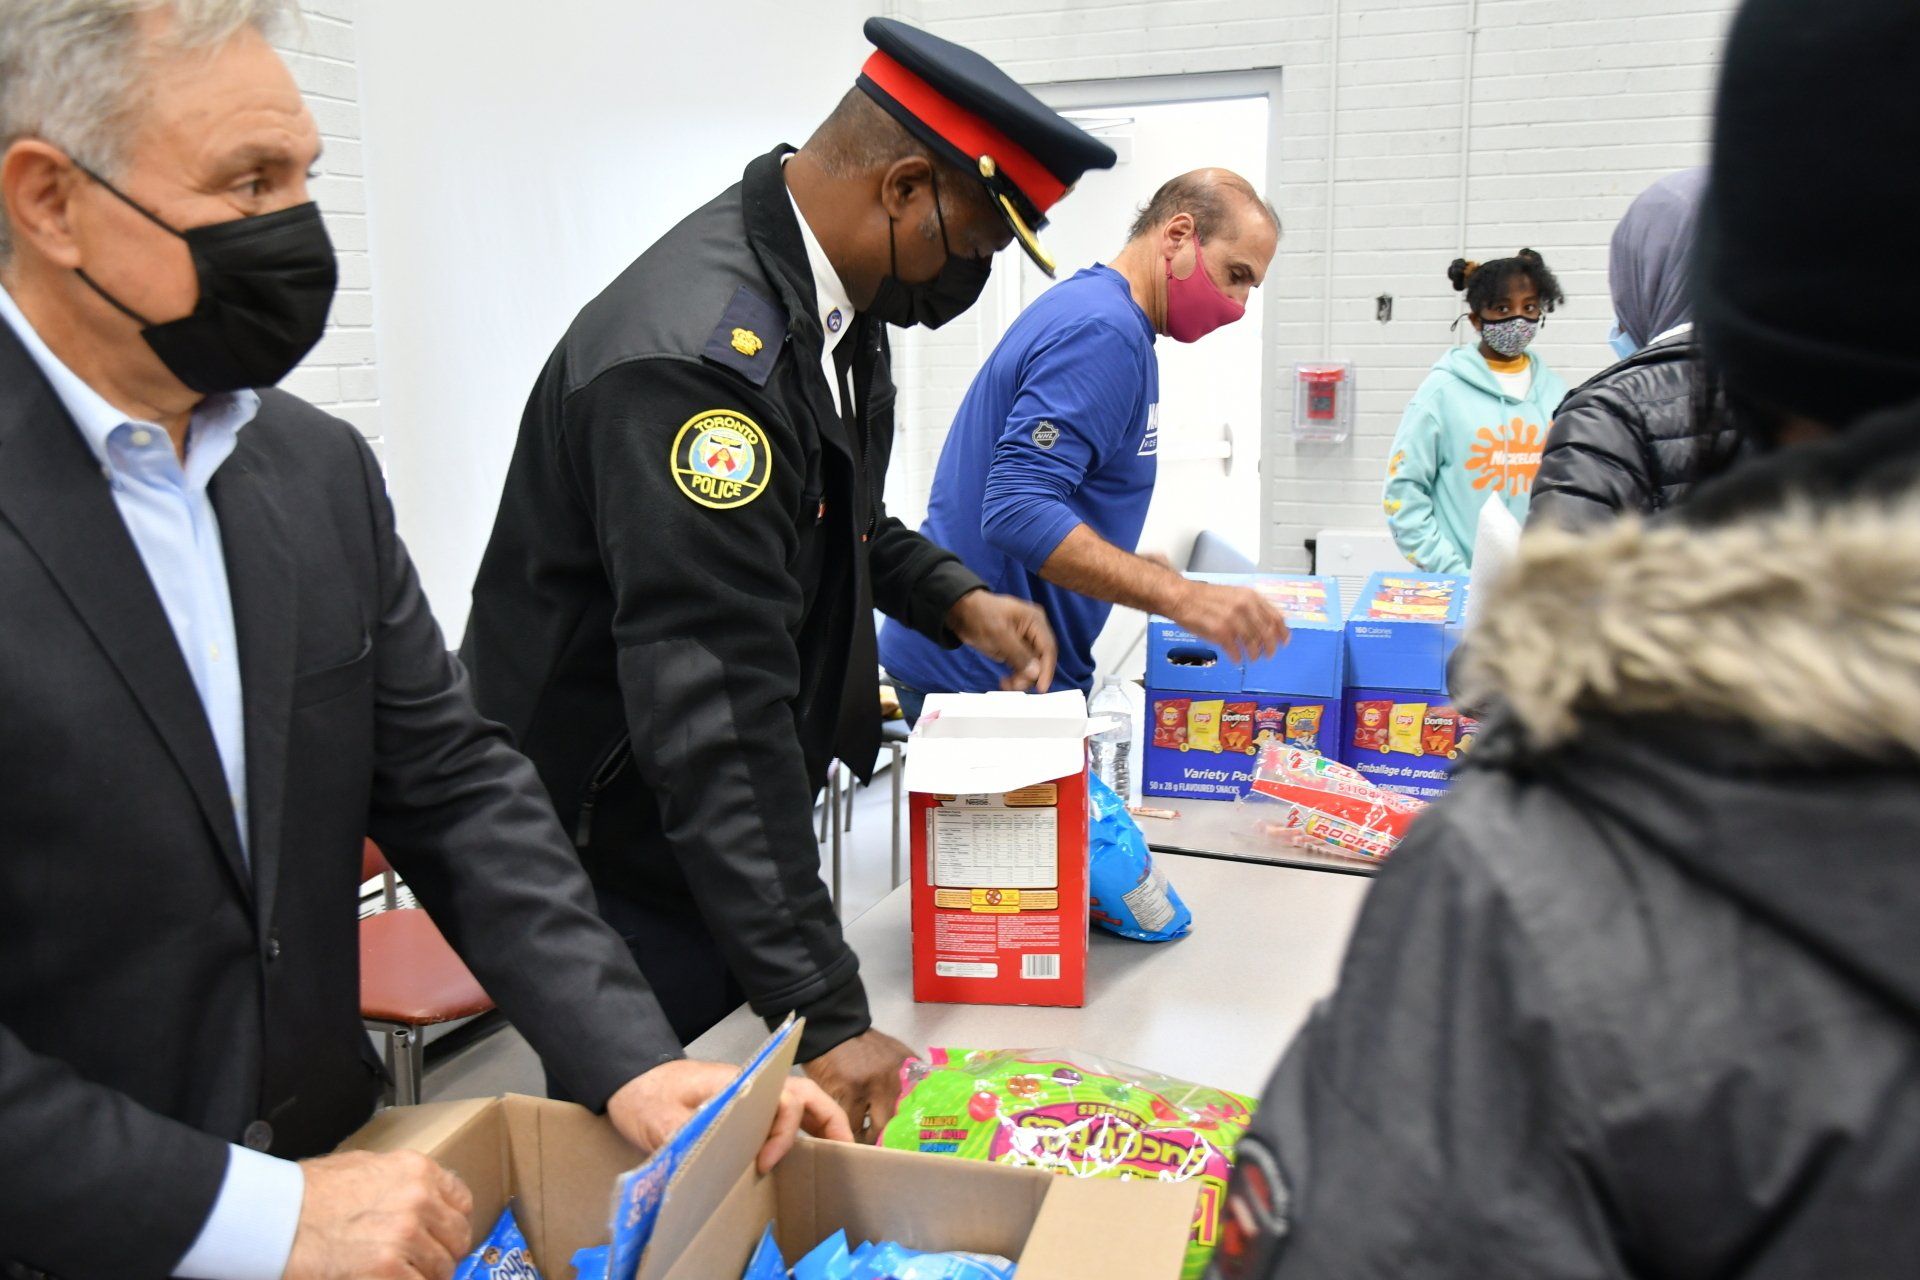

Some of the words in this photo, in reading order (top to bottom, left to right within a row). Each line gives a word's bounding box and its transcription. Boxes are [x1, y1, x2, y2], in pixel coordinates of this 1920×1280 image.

[694, 416, 759, 445] TORONTO
[692, 475, 742, 499] POLICE
[1184, 768, 1229, 782] Variety
[1232, 771, 1255, 782] Pac
[1357, 763, 1399, 776] Emballage
[1401, 767, 1412, 776] de
[1412, 768, 1448, 780] produits
[1149, 781, 1158, 790] 50
[1164, 782, 1172, 790] 28
[1173, 784, 1178, 792] g
[1179, 783, 1215, 792] FLAVOURED
[1216, 785, 1240, 794] SNACKS
[1315, 824, 1391, 853] ROCKET
